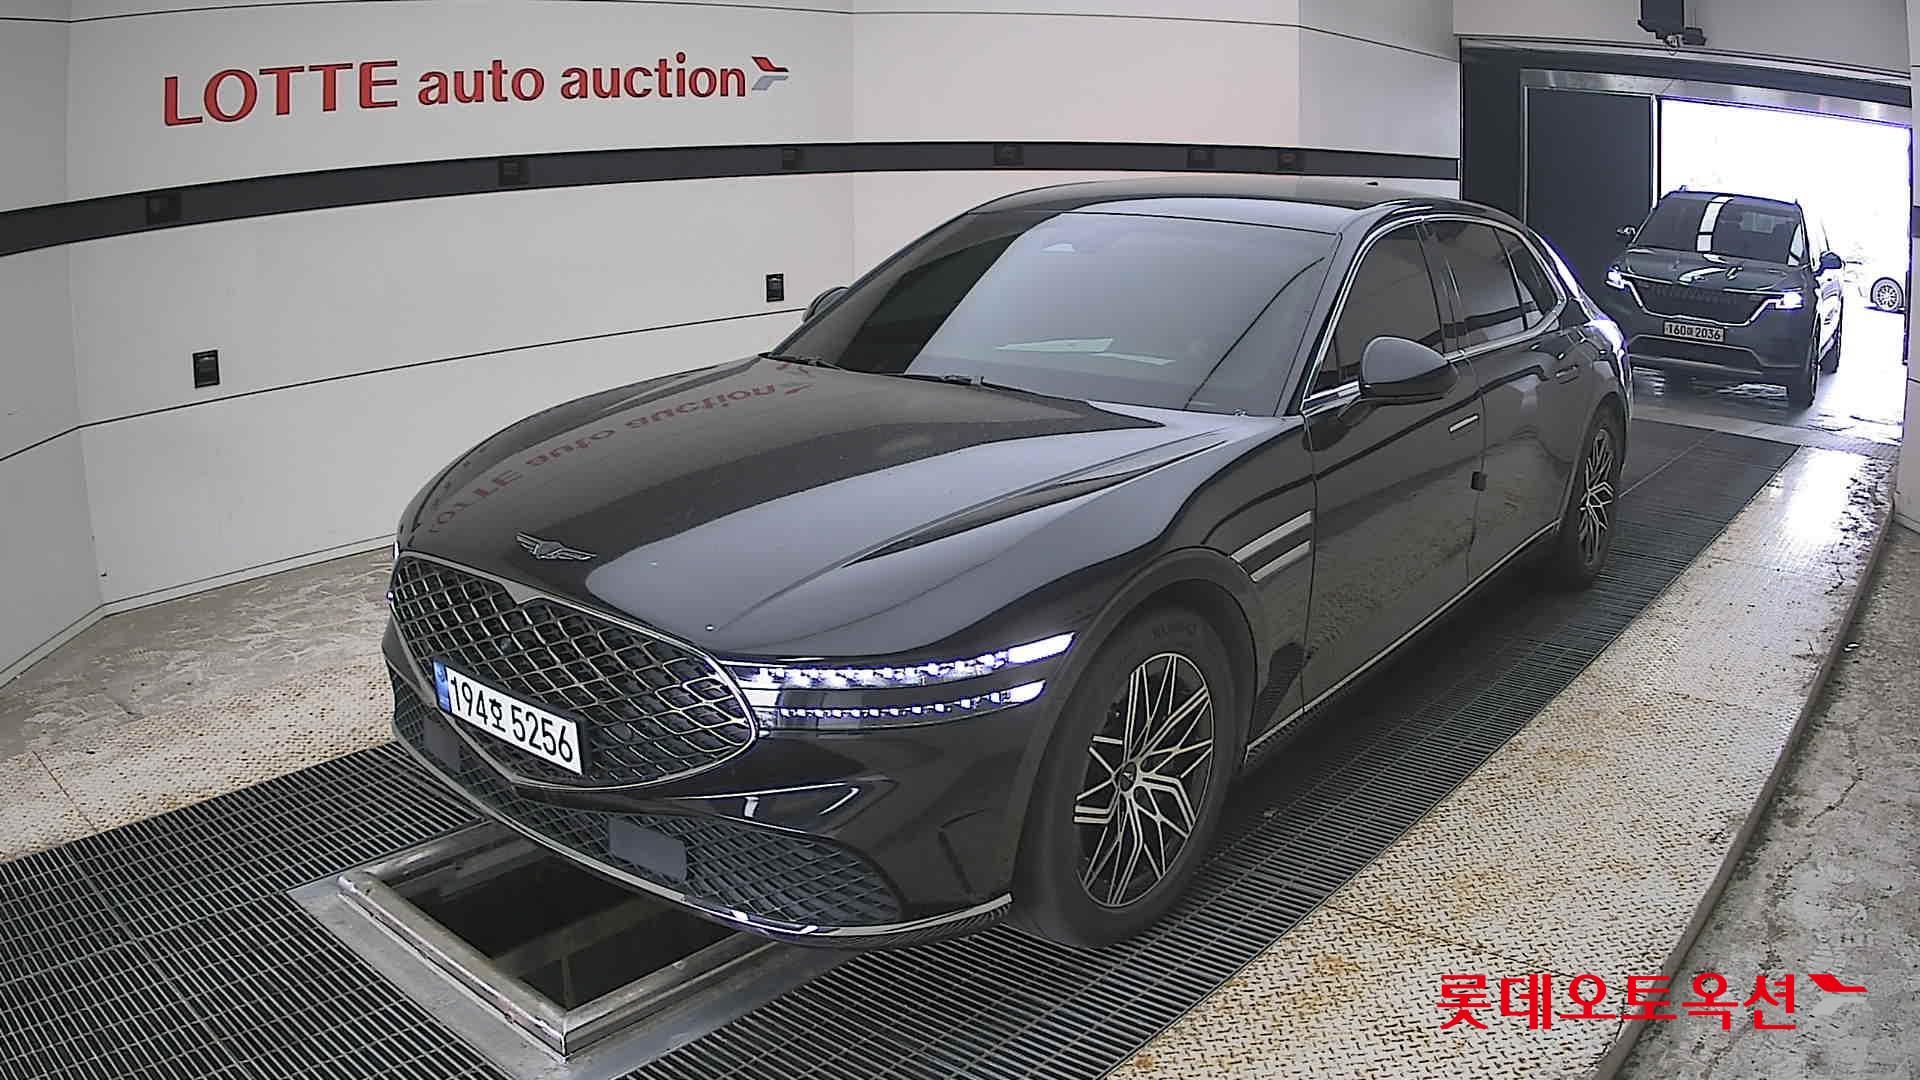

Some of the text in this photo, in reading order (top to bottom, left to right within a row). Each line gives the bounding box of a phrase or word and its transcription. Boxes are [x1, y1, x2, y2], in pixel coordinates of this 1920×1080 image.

[163, 51, 747, 126] LOTTE auto auction
[511, 704, 573, 763] 5256
